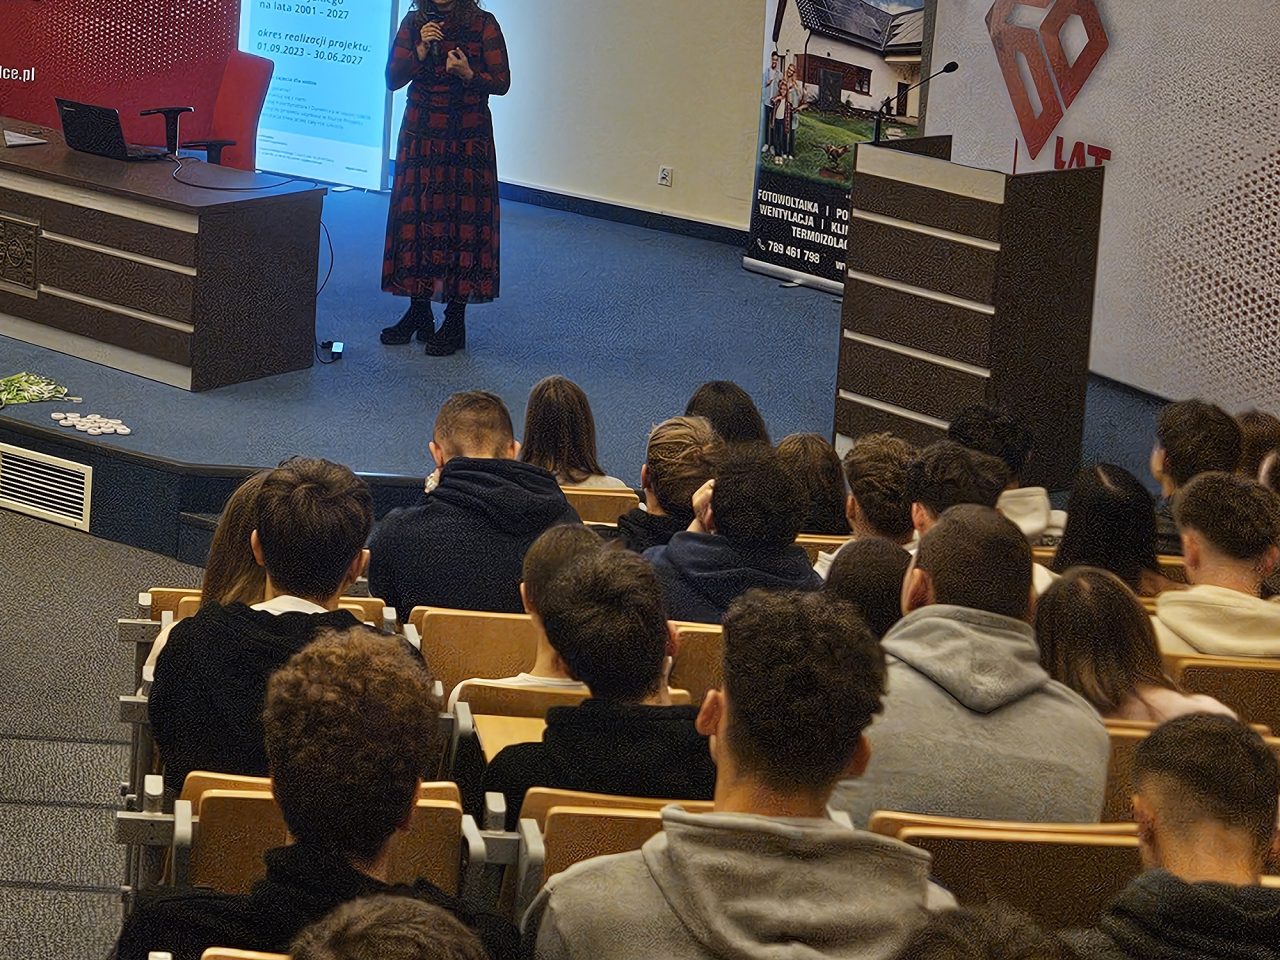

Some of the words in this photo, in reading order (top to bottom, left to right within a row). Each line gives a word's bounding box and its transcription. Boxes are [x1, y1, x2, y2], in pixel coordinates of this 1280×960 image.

[259, 1, 271, 9] na
[274, 1, 292, 12] lata
[294, 4, 317, 16] 2001
[326, 8, 350, 20] 2027
[258, 28, 282, 40] okres
[284, 32, 327, 46] realizacji
[257, 41, 304, 57] 01.09.2023
[313, 49, 363, 65] 30.06.2027
[1054, 135, 1111, 169] LAT
[757, 189, 819, 214] FOTOWOLTAIKA
[759, 204, 814, 228] WENTYLACJA
[785, 246, 801, 259] 461
